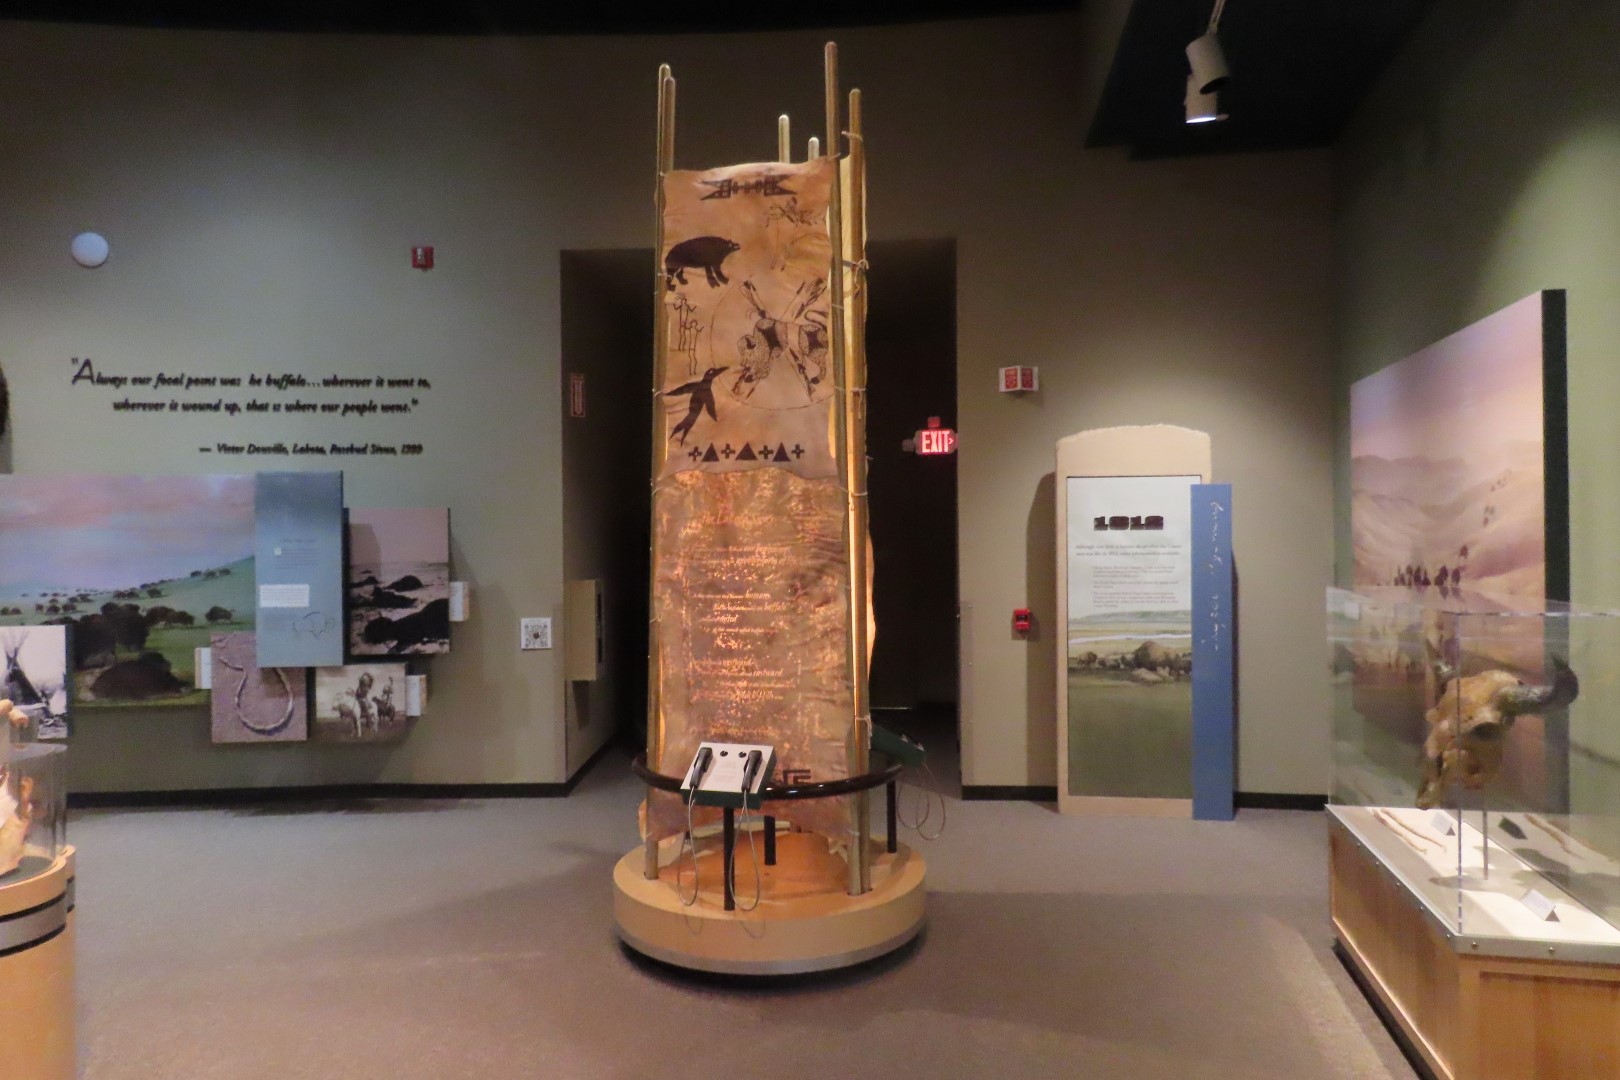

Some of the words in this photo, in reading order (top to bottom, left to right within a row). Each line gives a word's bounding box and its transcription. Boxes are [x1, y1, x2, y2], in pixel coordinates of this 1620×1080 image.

[131, 376, 152, 387] our
[153, 372, 185, 390] focal
[220, 376, 241, 387] was
[376, 375, 385, 387] it
[387, 376, 414, 387] went
[113, 398, 166, 412] wherever
[169, 399, 179, 412] it
[181, 398, 222, 412] wound
[246, 398, 269, 412] that
[285, 398, 318, 413] where
[321, 402, 340, 413] our
[341, 398, 378, 417] people
[921, 430, 950, 453] EXIT
